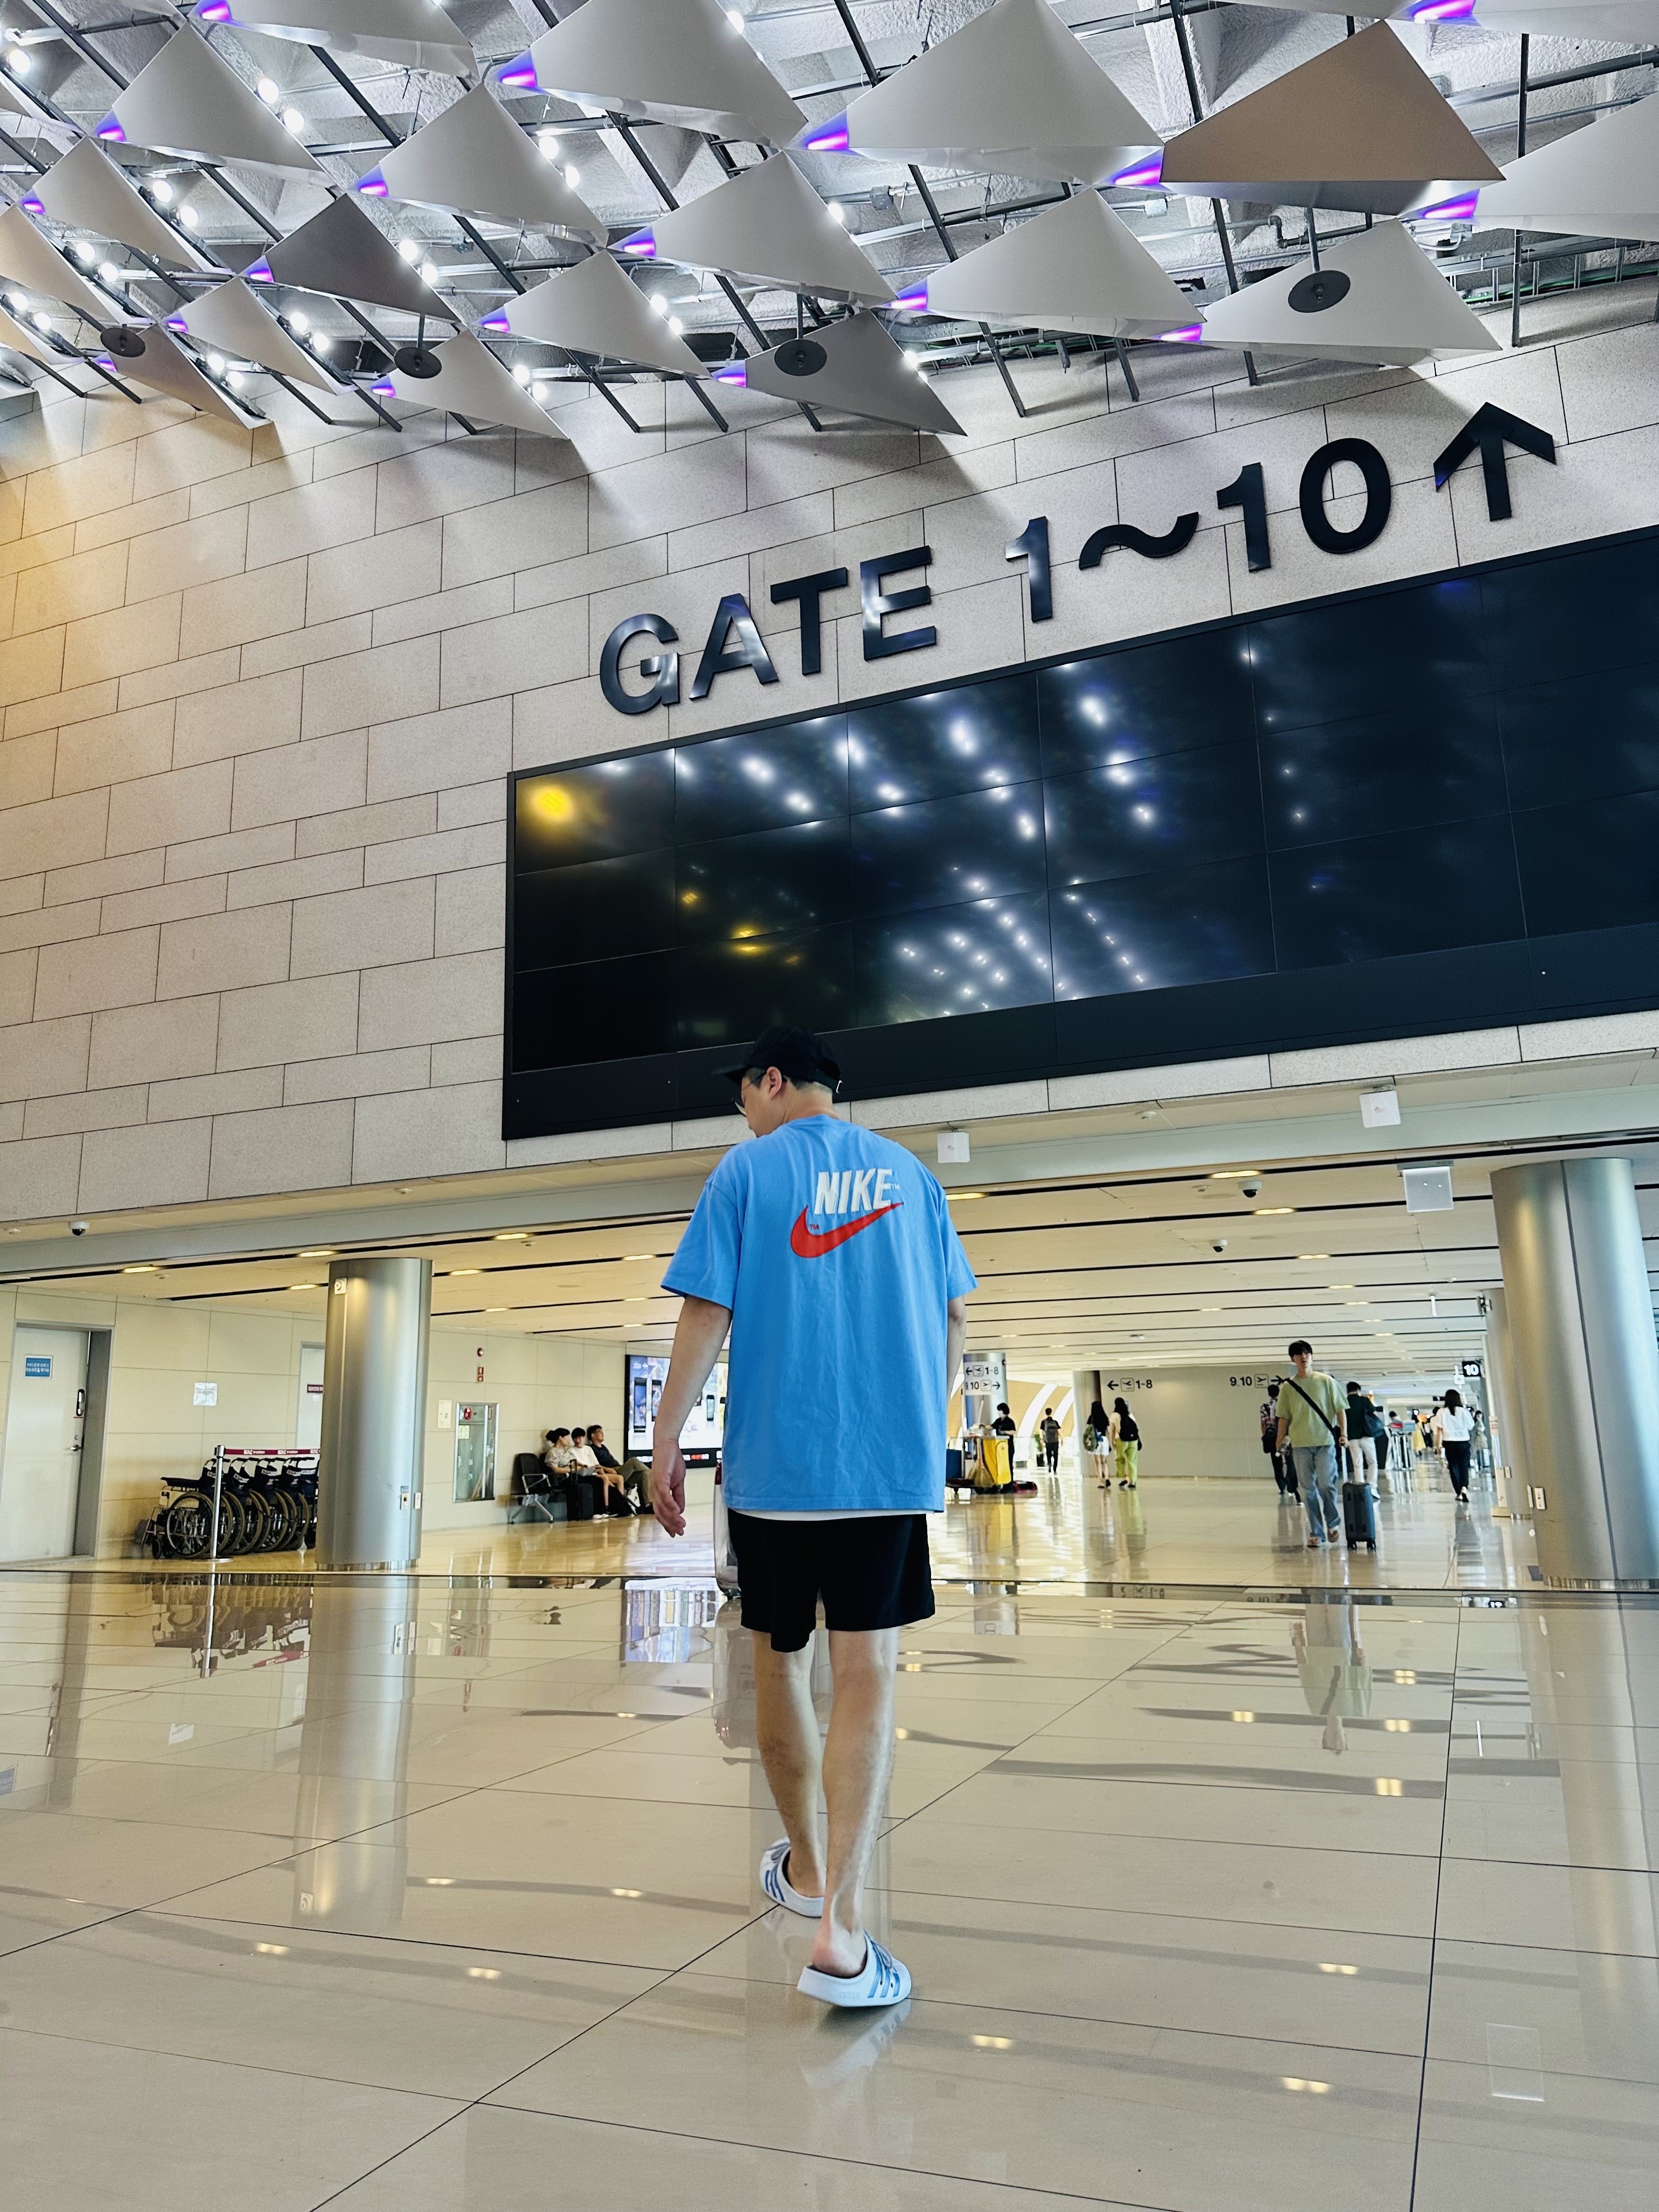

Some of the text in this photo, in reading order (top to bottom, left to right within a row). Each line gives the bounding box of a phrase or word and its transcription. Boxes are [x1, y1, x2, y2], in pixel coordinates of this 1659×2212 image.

[600, 545, 937, 715] GATE
[814, 1168, 893, 1215] NIKE
[1464, 1364, 1480, 1376] 10
